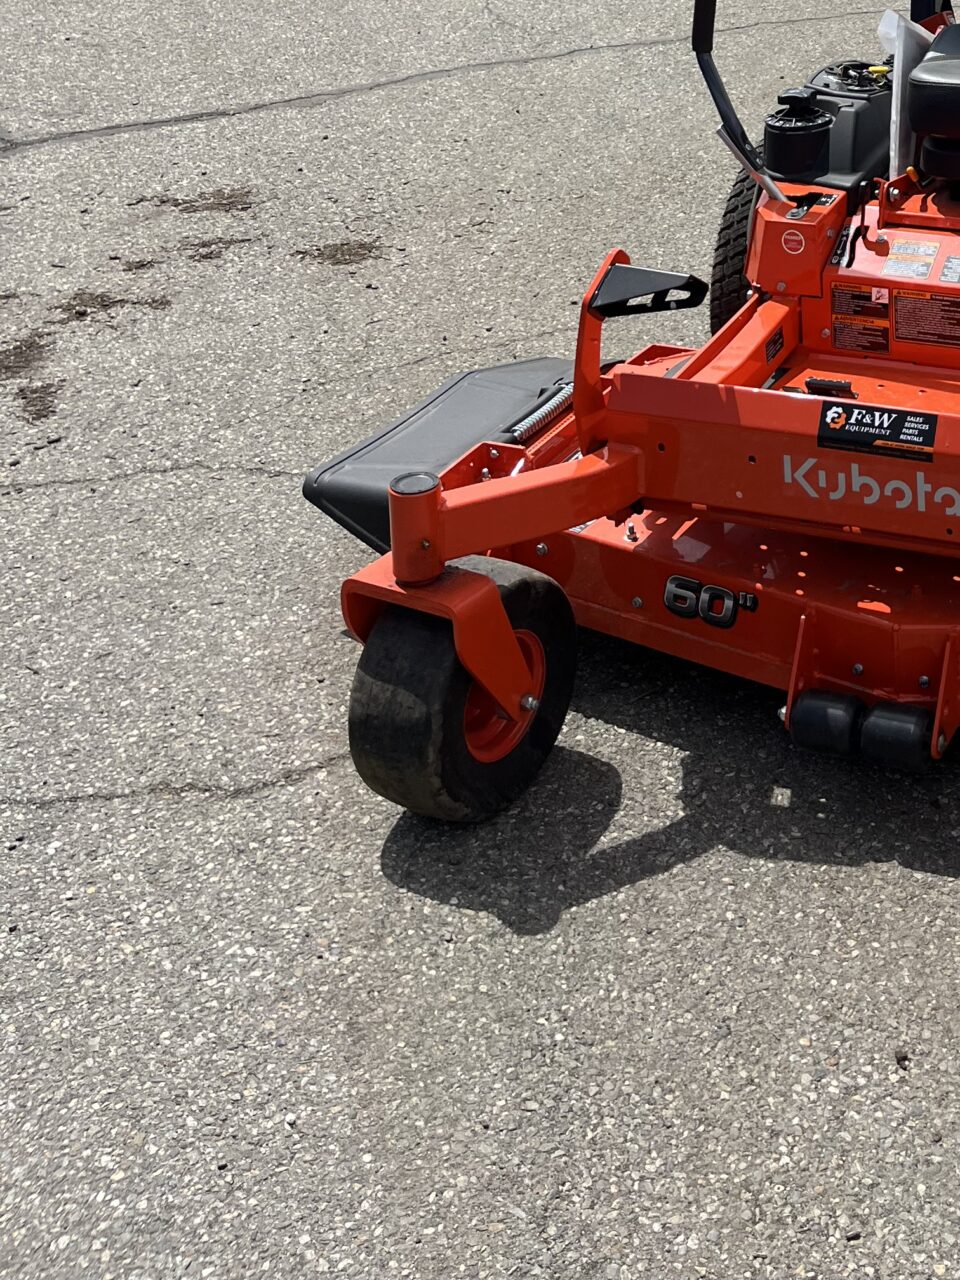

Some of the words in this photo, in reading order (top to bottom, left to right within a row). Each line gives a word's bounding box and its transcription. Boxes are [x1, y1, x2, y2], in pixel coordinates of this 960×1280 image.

[848, 408, 898, 428] F&W
[906, 415, 923, 423] SALES
[845, 424, 891, 436] EQUIPMENT
[904, 422, 929, 430] SERVICES
[899, 434, 923, 442] RENTALS
